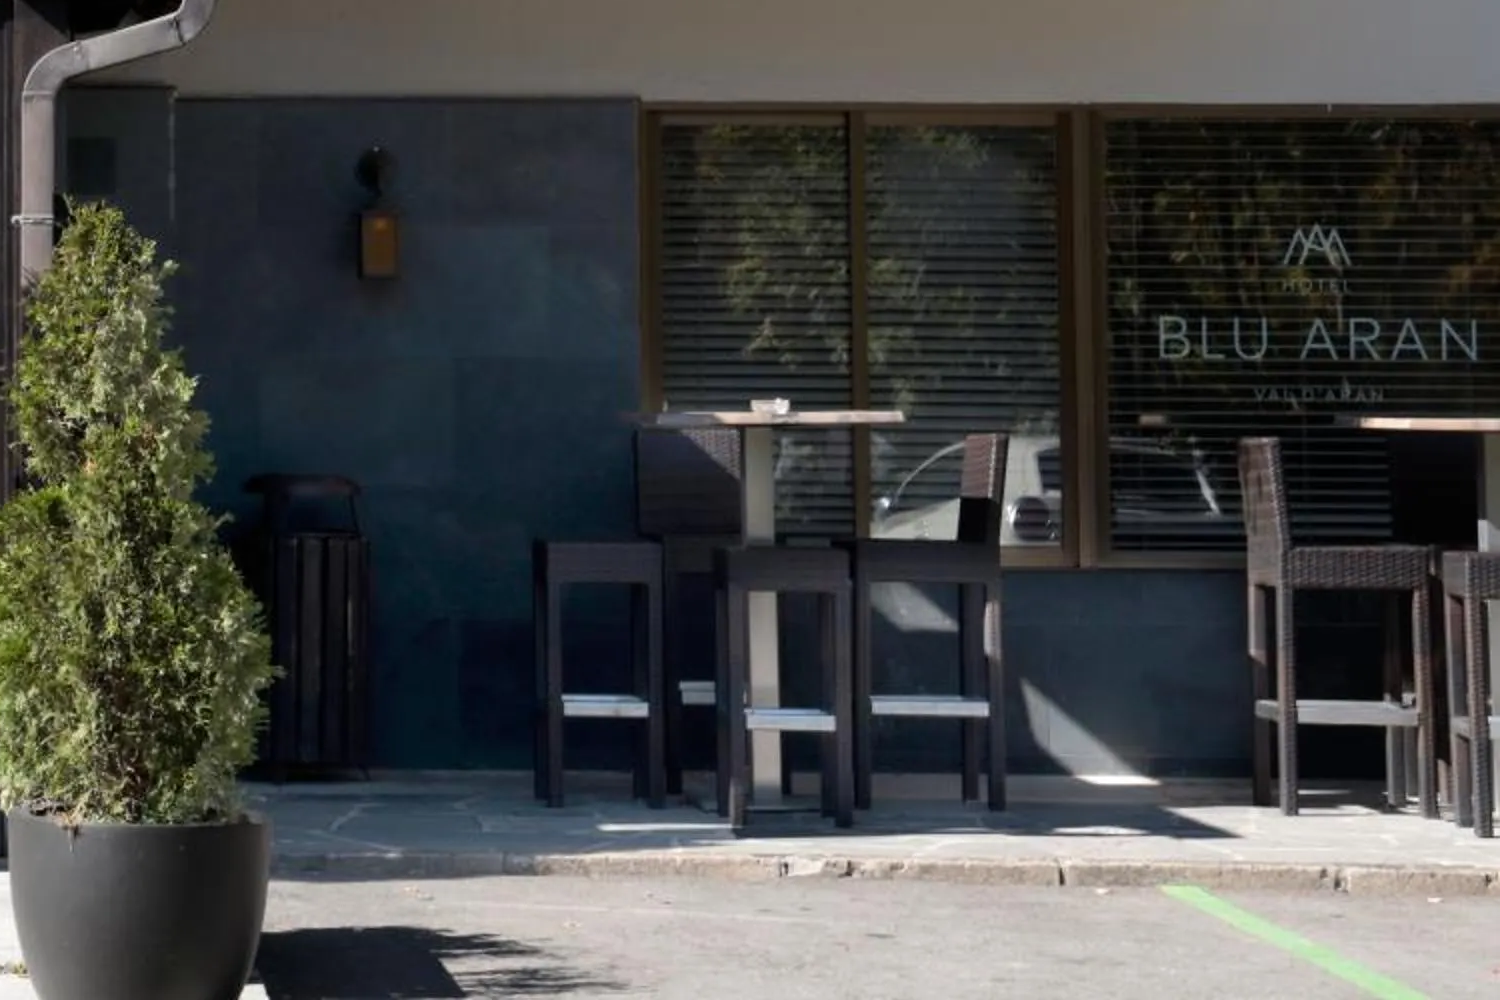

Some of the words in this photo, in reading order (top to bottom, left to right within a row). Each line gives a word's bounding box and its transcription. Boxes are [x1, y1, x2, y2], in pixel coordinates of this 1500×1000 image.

[1281, 278, 1351, 295] HOTEL
[1158, 315, 1269, 362] BLU
[1300, 317, 1478, 362] ARAN
